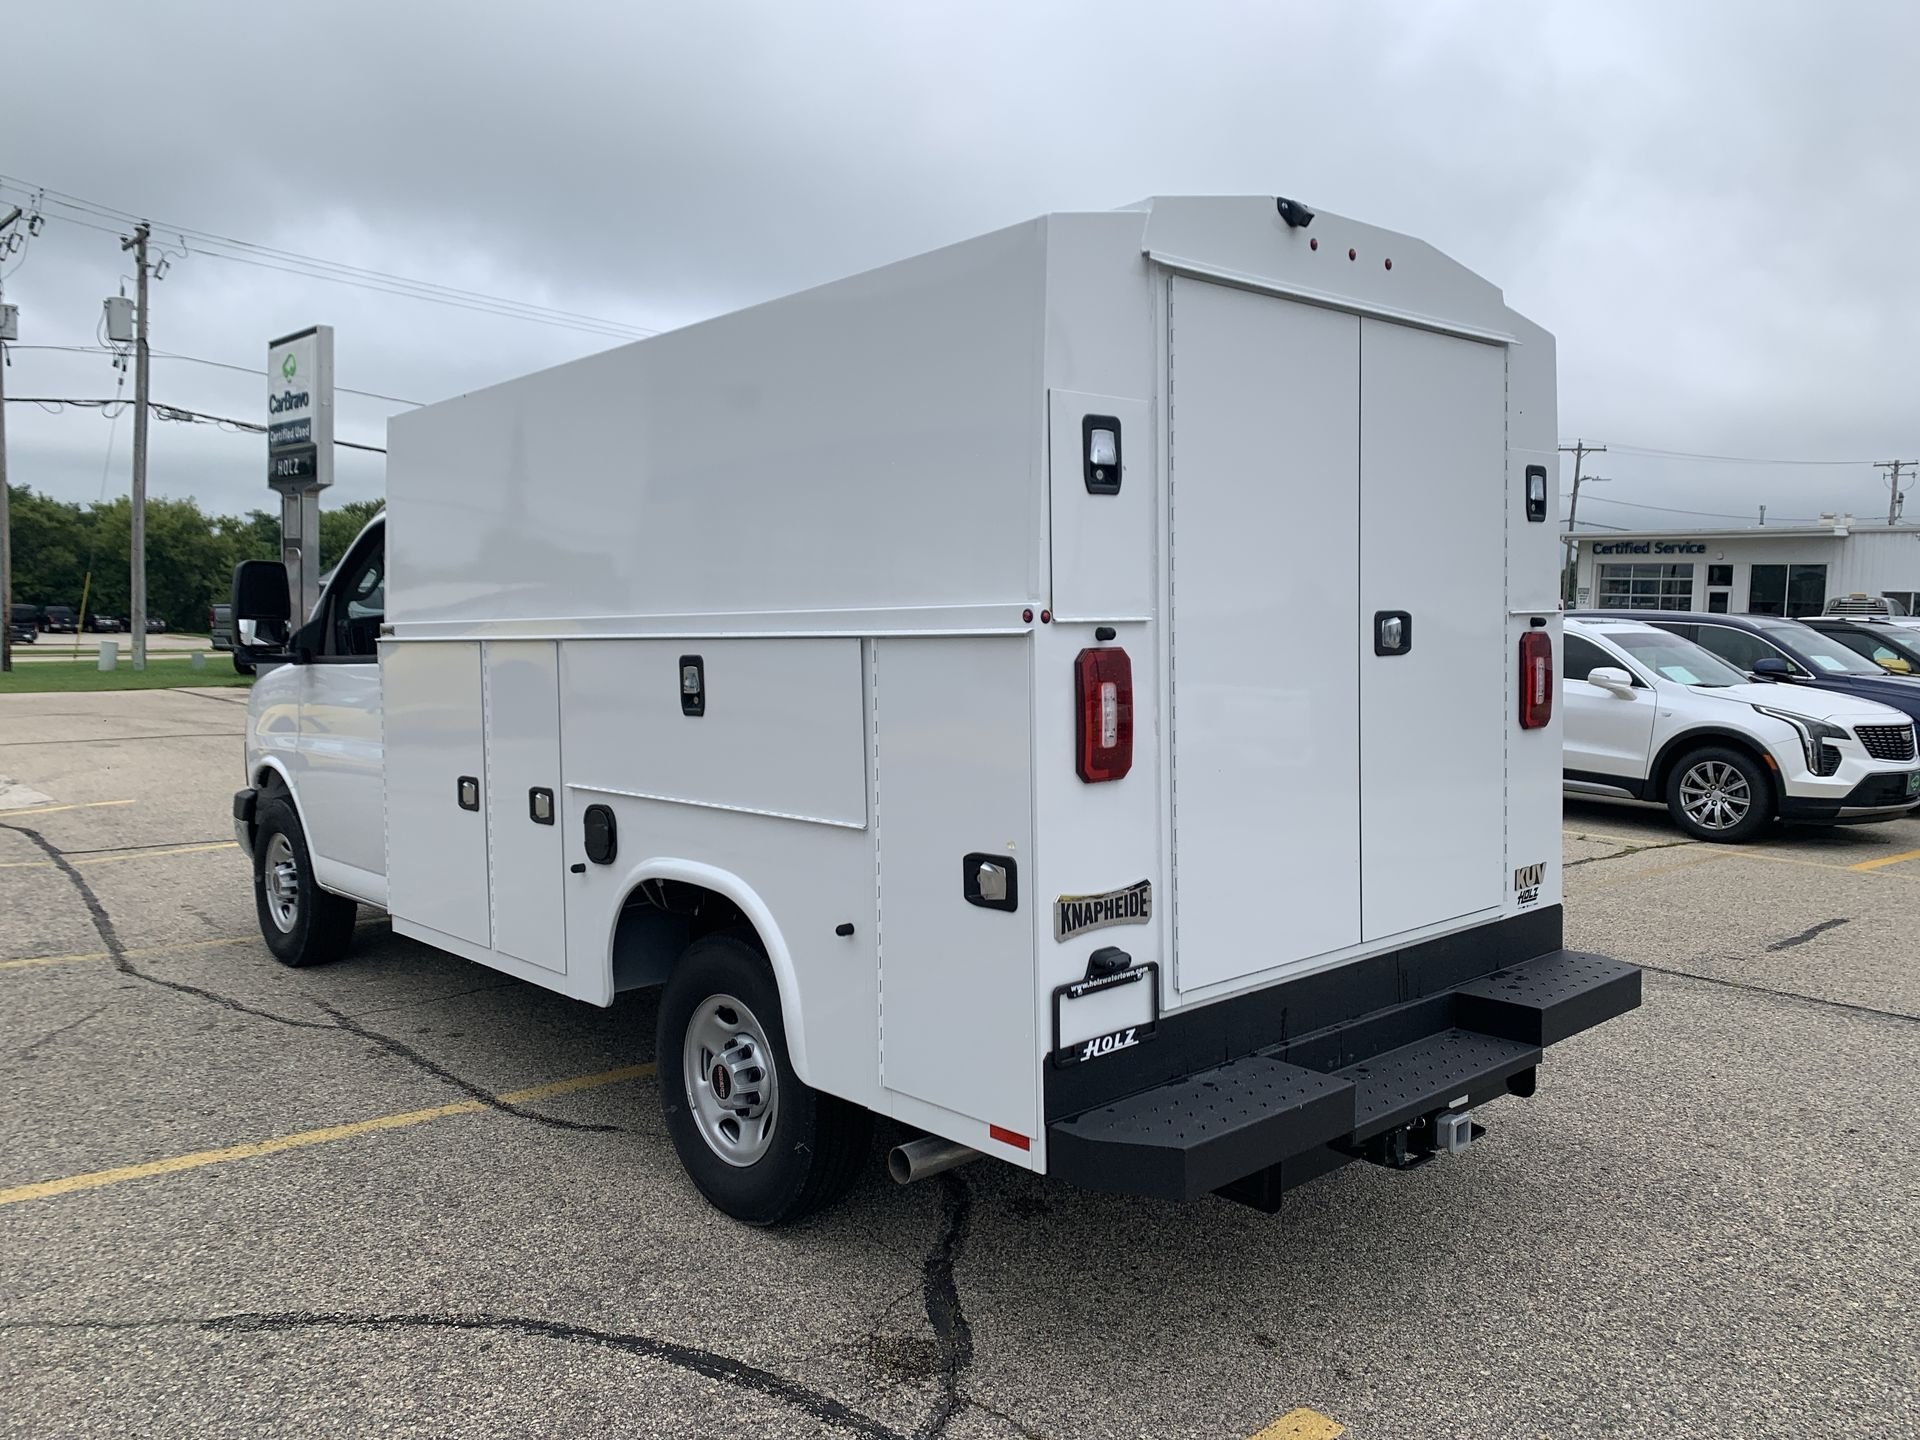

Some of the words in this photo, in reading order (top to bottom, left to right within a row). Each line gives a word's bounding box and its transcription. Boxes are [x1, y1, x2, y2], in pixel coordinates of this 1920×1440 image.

[269, 390, 309, 414] CarBravo
[270, 426, 294, 443] Certified
[295, 423, 310, 438] Used
[277, 458, 299, 476] HOLZ
[1592, 542, 1650, 556] Certified
[1654, 541, 1706, 554] Service
[1514, 861, 1547, 891] KUV
[1517, 887, 1539, 905] HOLZ
[1061, 887, 1148, 935] KNAPHEIDE
[1080, 1028, 1139, 1062] HOLZ
